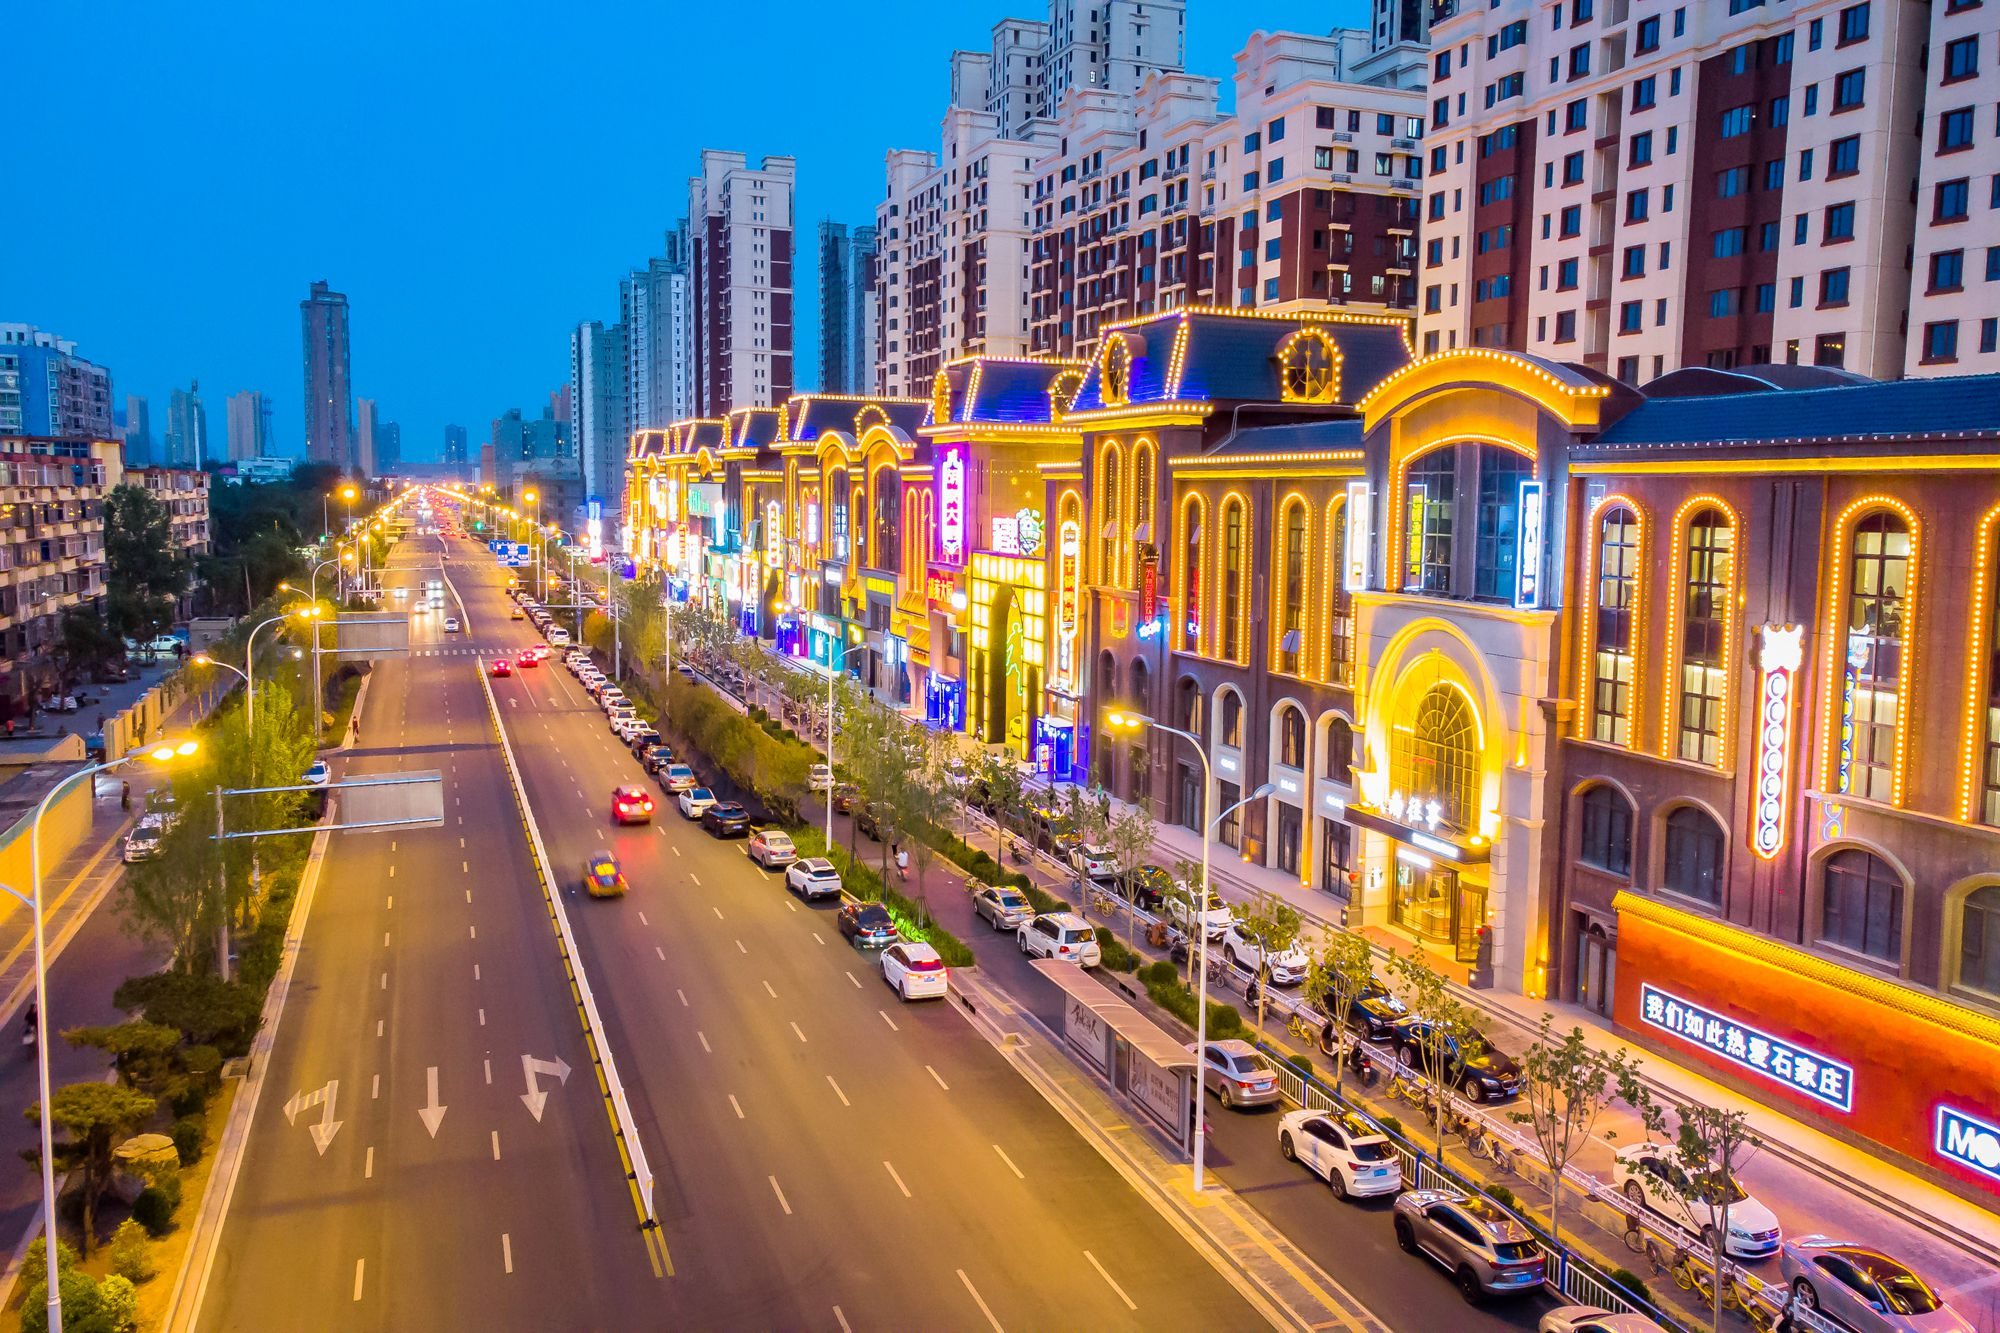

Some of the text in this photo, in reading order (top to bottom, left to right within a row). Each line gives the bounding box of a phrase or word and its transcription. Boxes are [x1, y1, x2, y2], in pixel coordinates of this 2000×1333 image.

[1646, 995, 1843, 1099] 我们如此热爱石家庄
